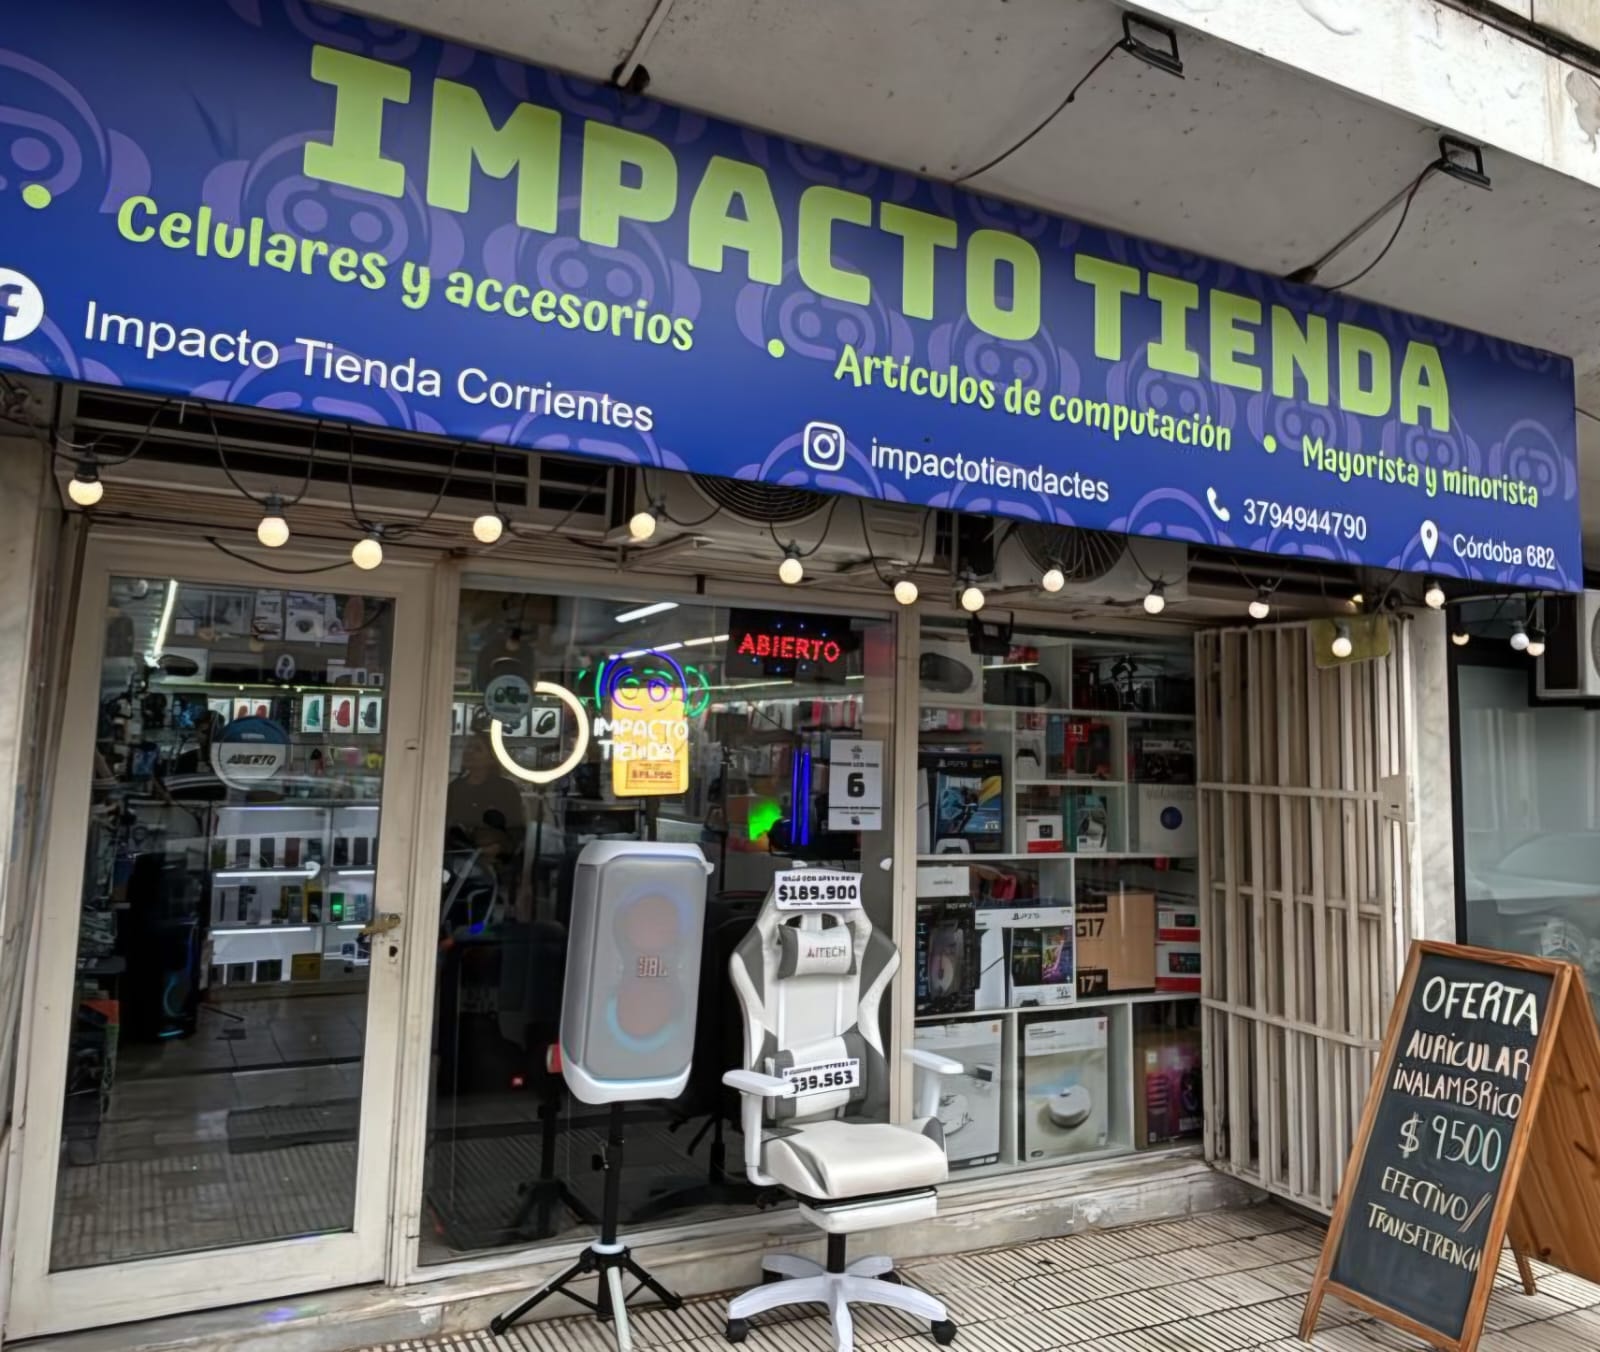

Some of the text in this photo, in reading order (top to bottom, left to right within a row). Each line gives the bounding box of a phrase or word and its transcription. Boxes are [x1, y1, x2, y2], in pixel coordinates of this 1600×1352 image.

[305, 45, 1449, 432] IMPACTO TIENDA
[118, 196, 694, 351] Celulares y accesorios
[85, 301, 653, 432] Impacto Tienda Corrientes
[834, 344, 1231, 451] Artículos de computación
[871, 444, 1110, 503] impactotiendactes
[1303, 435, 1538, 508] Mayorista y minorista
[1244, 498, 1367, 541] 3794944790
[1452, 531, 1555, 570] Córdoba 682
[738, 633, 839, 662] ABIERTO
[593, 717, 689, 741] IMPACTO
[597, 739, 676, 762] TIENDA
[847, 772, 865, 797] 6
[778, 884, 857, 902] $189.900
[1421, 975, 1539, 1036] OFERTA
[1405, 1029, 1531, 1082] AURICULAR
[1392, 1064, 1523, 1120] INALAMBRICO
[1398, 1112, 1502, 1173] $ 9500
